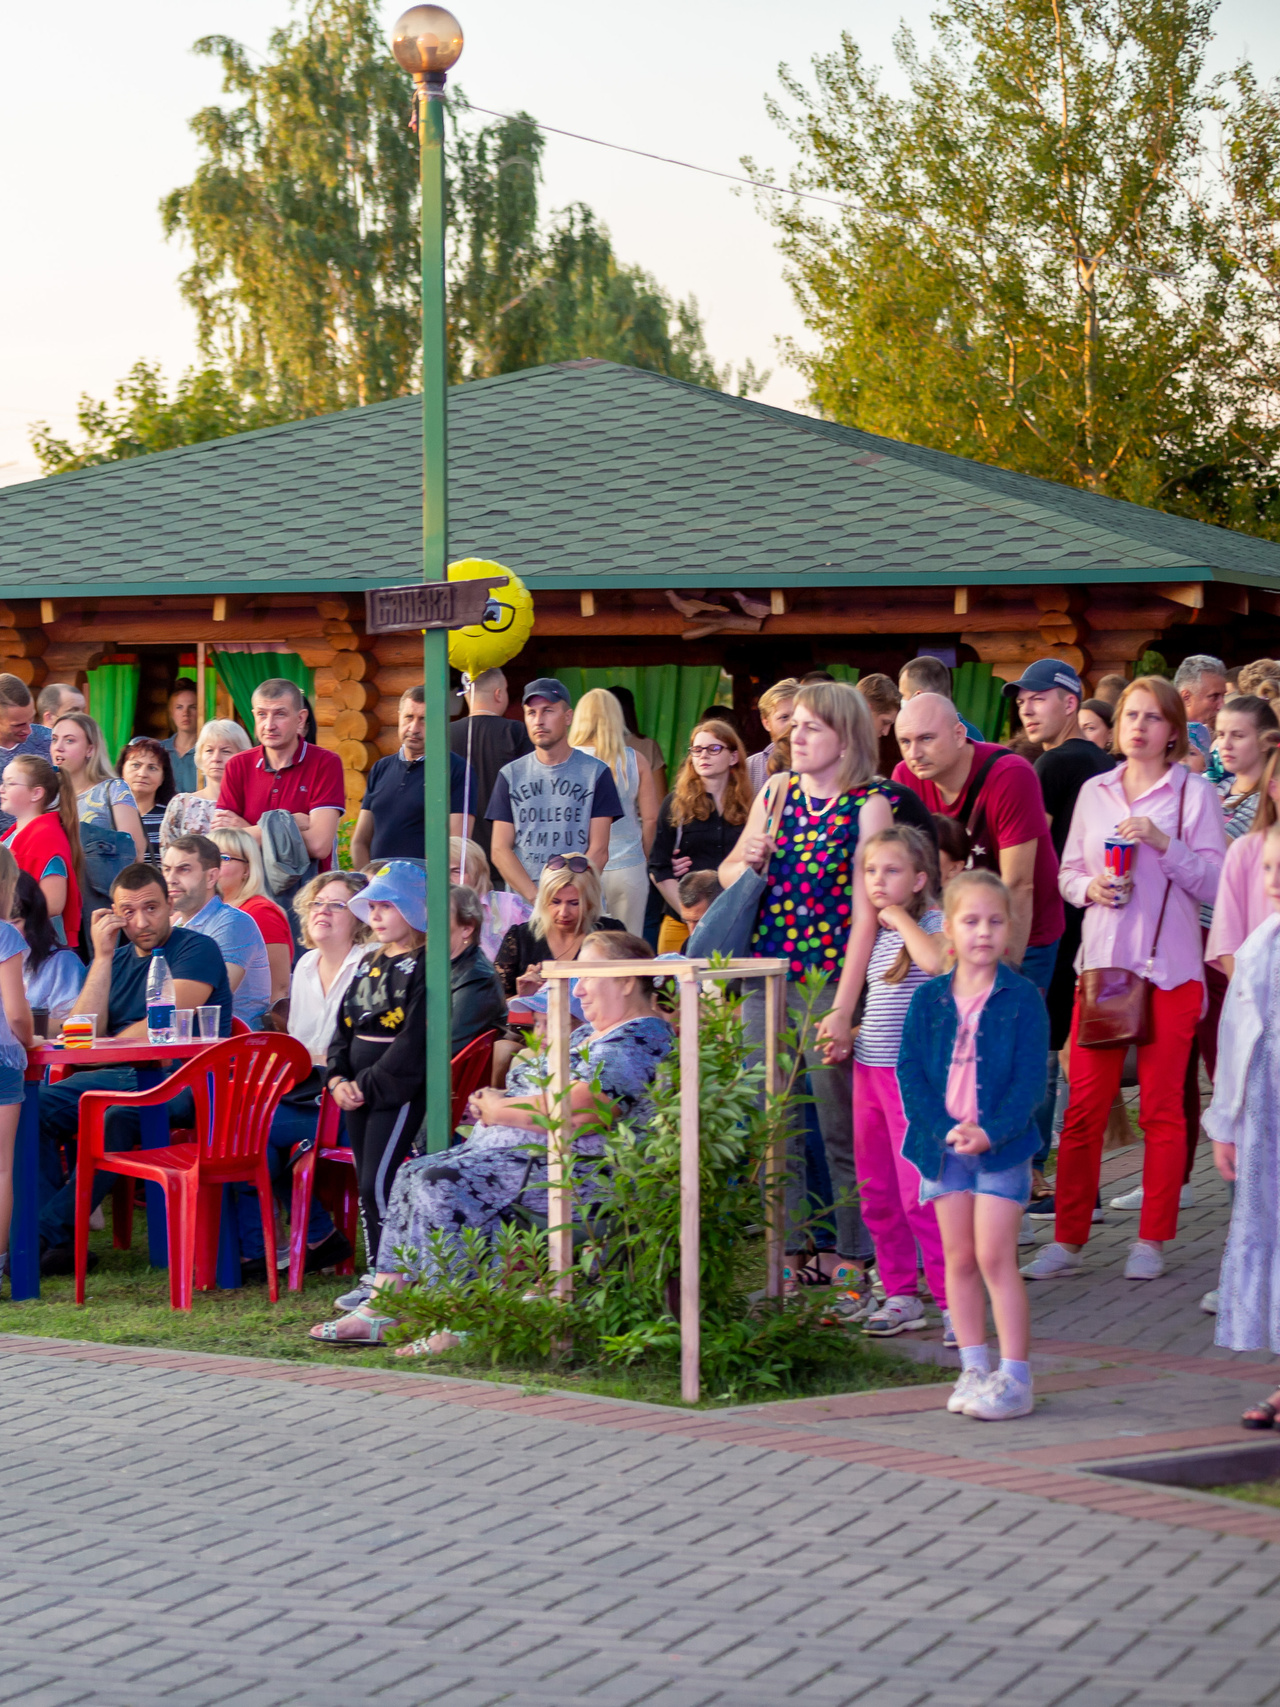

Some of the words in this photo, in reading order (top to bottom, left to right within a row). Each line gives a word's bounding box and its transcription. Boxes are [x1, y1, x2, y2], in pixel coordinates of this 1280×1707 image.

[509, 778, 544, 807] NEW
[550, 777, 594, 807] YORK
[519, 806, 582, 823] COLLEGE
[514, 828, 588, 848] CAMPUS
